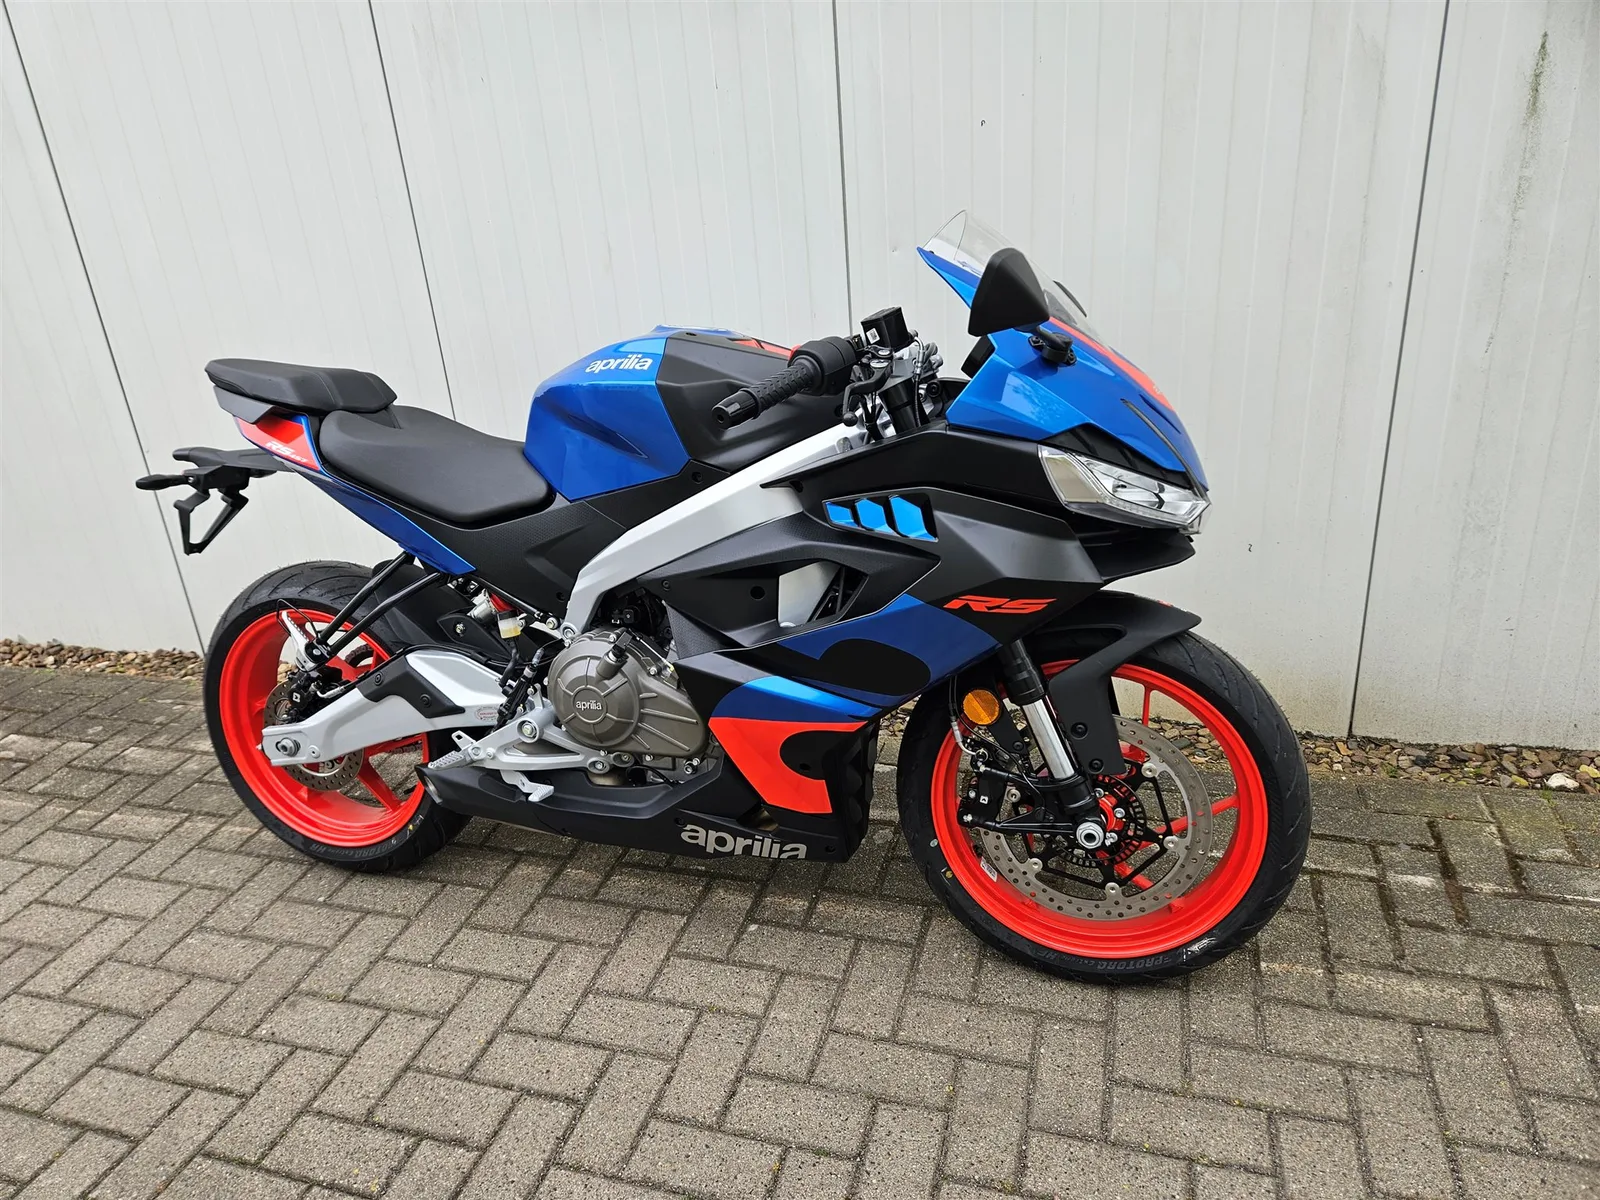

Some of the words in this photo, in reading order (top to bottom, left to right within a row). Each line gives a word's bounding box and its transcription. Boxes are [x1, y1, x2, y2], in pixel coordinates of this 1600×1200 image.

[585, 354, 653, 374] aprilia
[265, 441, 296, 456] RS
[943, 594, 1058, 614] RS
[575, 699, 603, 711] aprilia
[680, 823, 808, 860] aprilia
